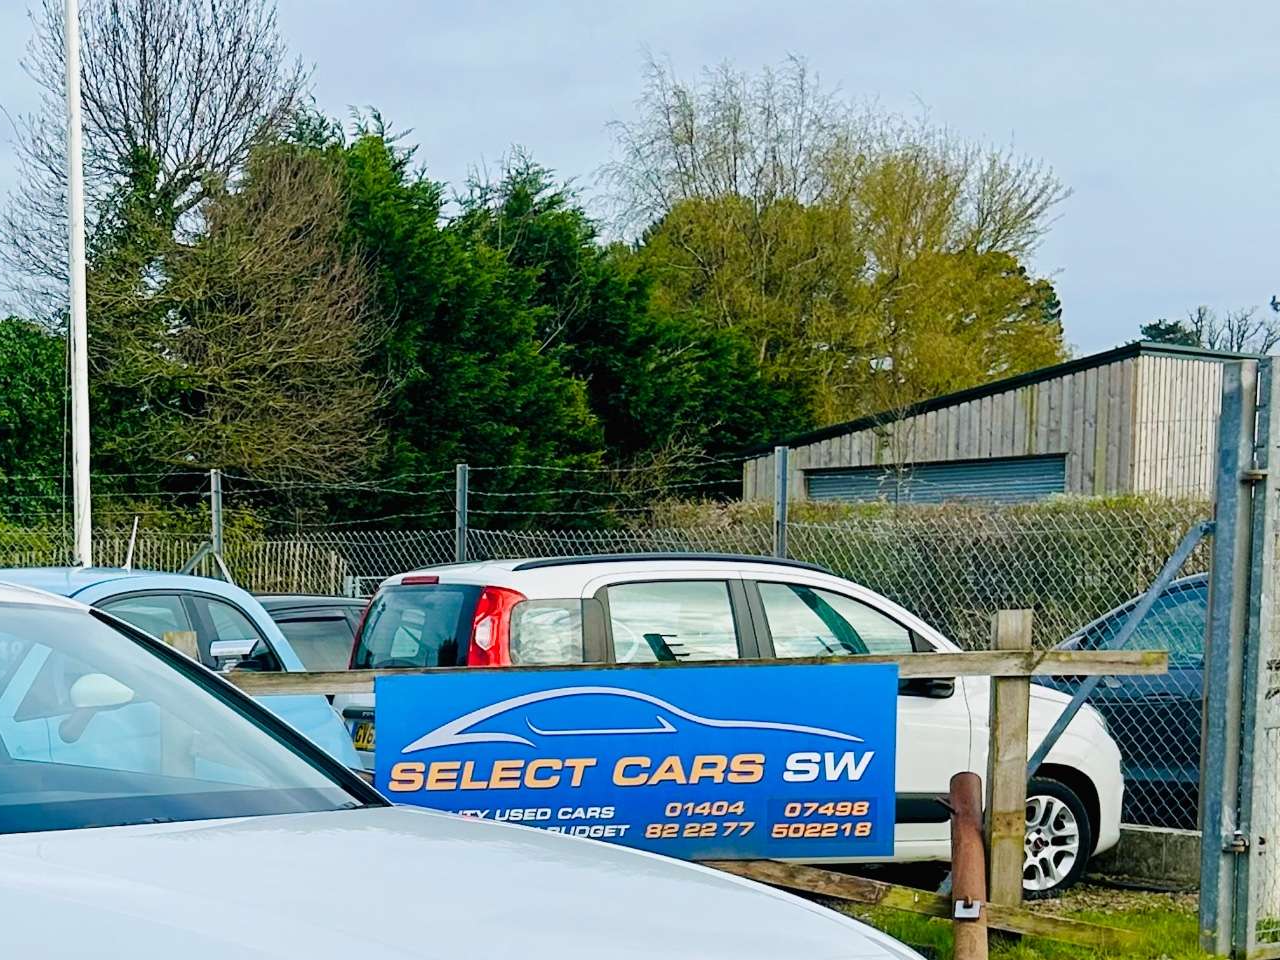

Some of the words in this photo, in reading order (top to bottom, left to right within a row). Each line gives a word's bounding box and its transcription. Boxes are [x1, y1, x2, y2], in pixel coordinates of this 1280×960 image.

[388, 757, 597, 792] SELECT
[612, 753, 766, 787] CARS
[782, 751, 875, 783] SW
[494, 808, 552, 821] USED
[557, 806, 616, 819] CARS
[665, 801, 745, 817] 01404
[784, 802, 870, 817] 07498
[771, 821, 873, 837] 502218
